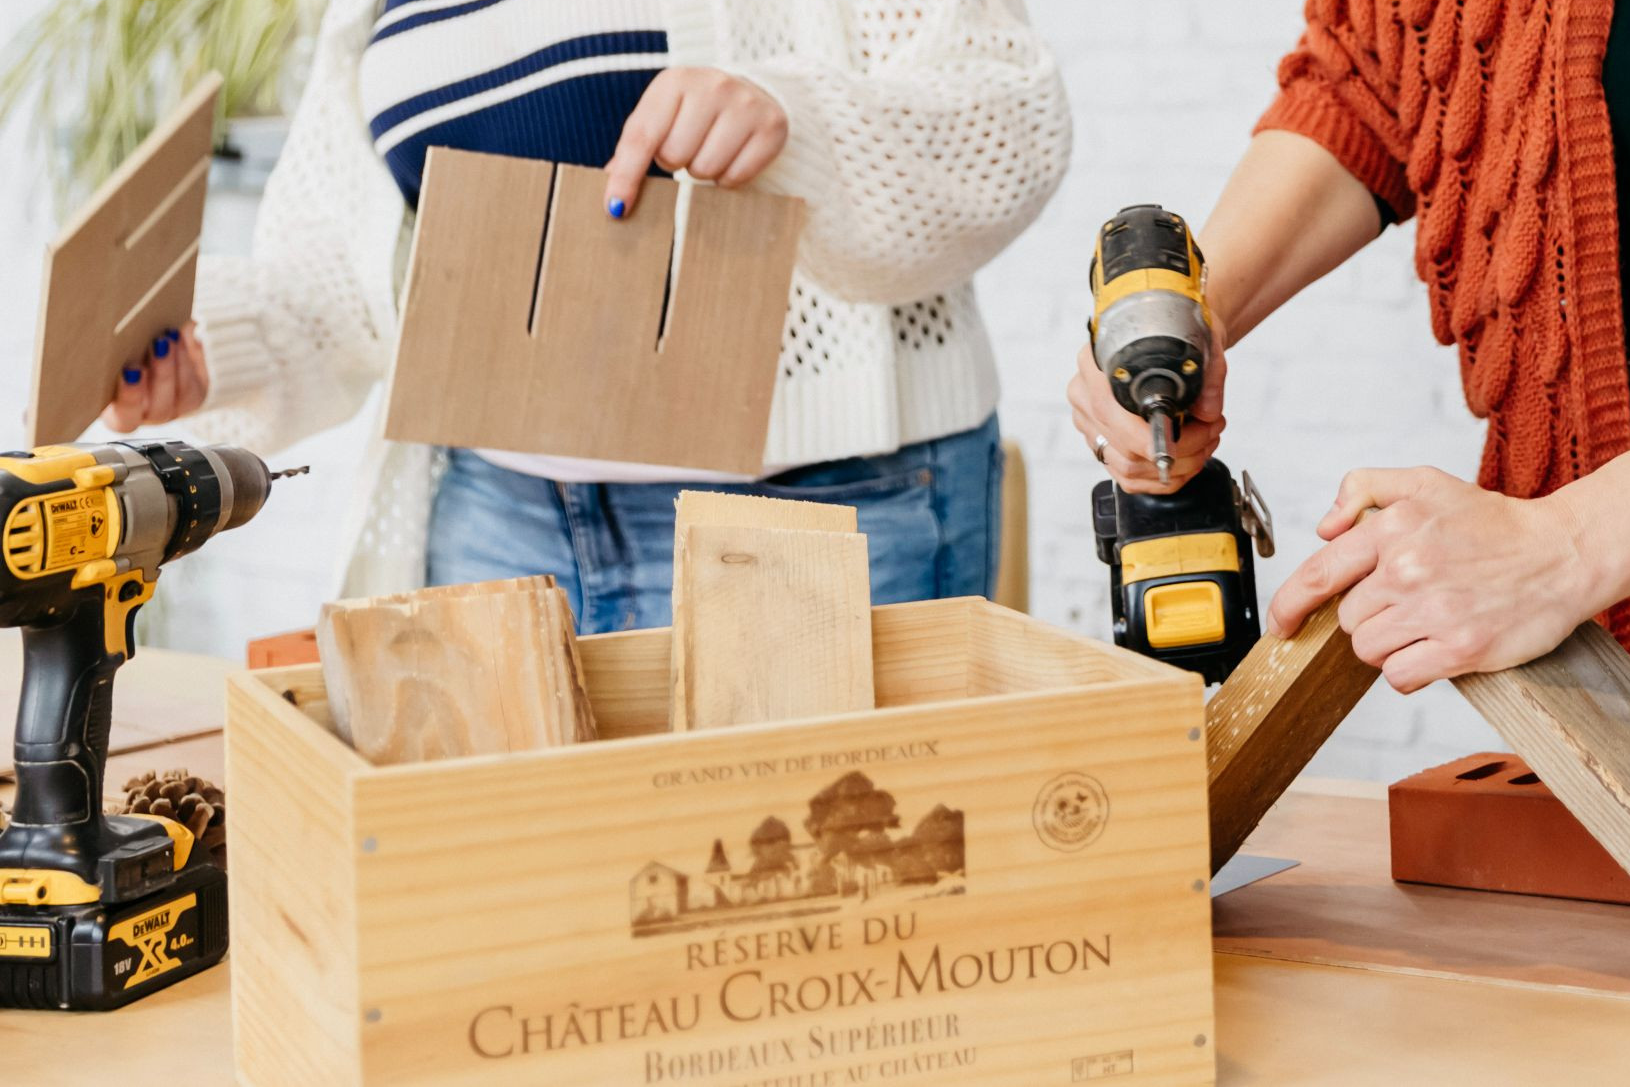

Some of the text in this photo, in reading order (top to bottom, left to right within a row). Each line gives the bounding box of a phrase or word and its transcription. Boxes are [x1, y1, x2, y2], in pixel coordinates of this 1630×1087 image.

[652, 740, 940, 789] GRAND VIN DE BORDEAUX
[133, 911, 170, 938] DEWALT
[686, 912, 918, 971] RÉSERVE DU
[114, 957, 132, 976] 18V
[468, 934, 1113, 1059] CHÂTEAU CROIX-MOUTON
[644, 1013, 961, 1085] BORDEAUX SUPÉRIEUR
[846, 1063, 872, 1084] AU
[879, 1047, 978, 1080] CHÂTEAU
